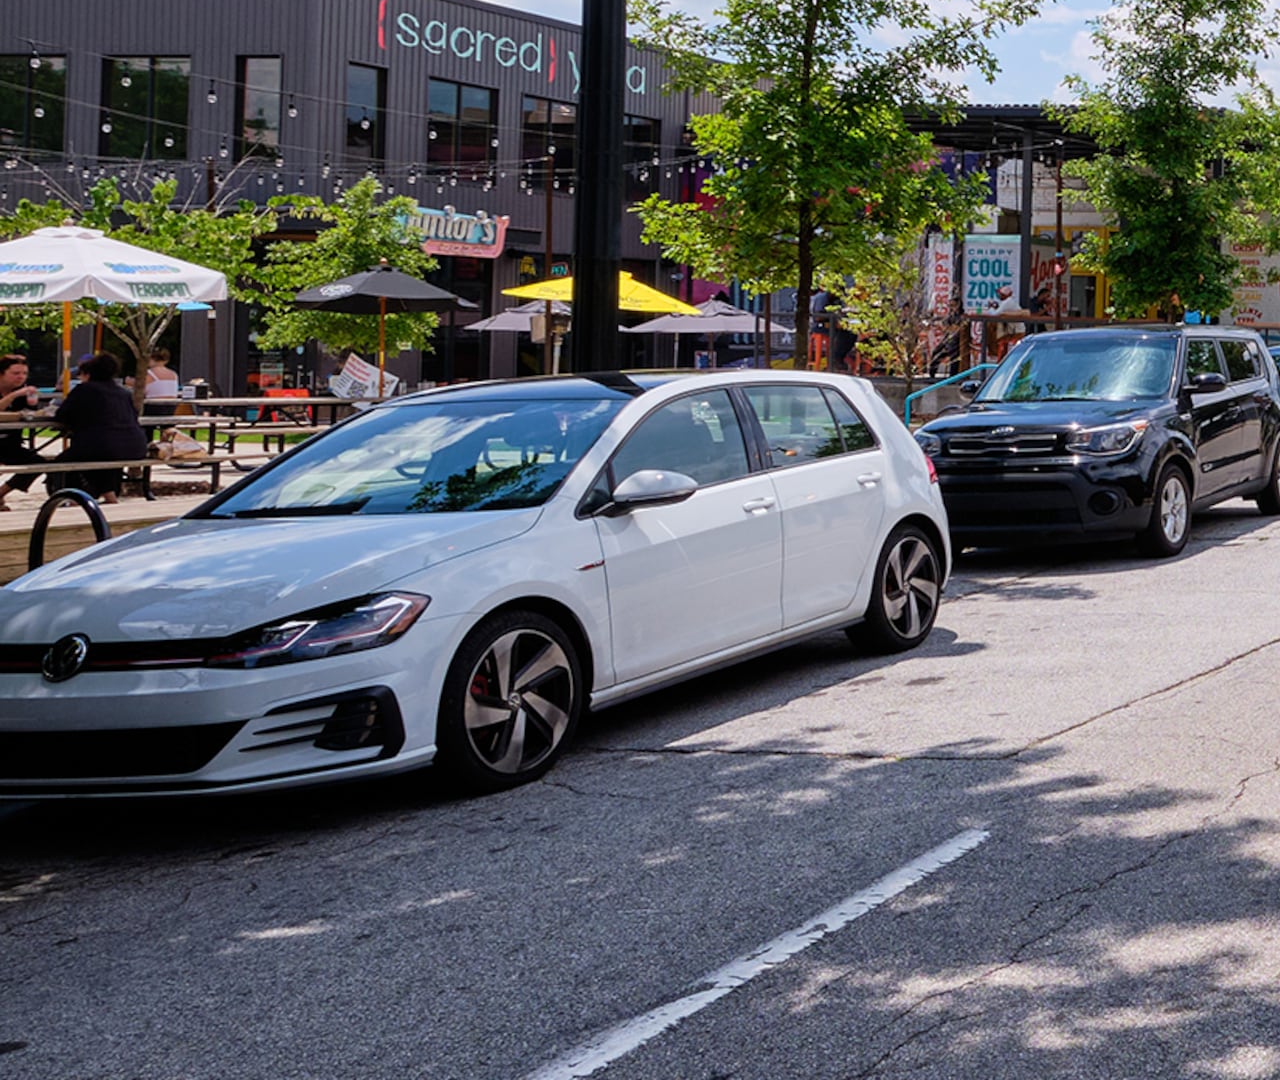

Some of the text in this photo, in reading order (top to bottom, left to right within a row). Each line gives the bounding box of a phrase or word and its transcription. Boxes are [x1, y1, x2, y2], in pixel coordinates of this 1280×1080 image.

[568, 51, 646, 94] ya
[968, 259, 1012, 277] COOL
[126, 282, 194, 298] TERRAPIN
